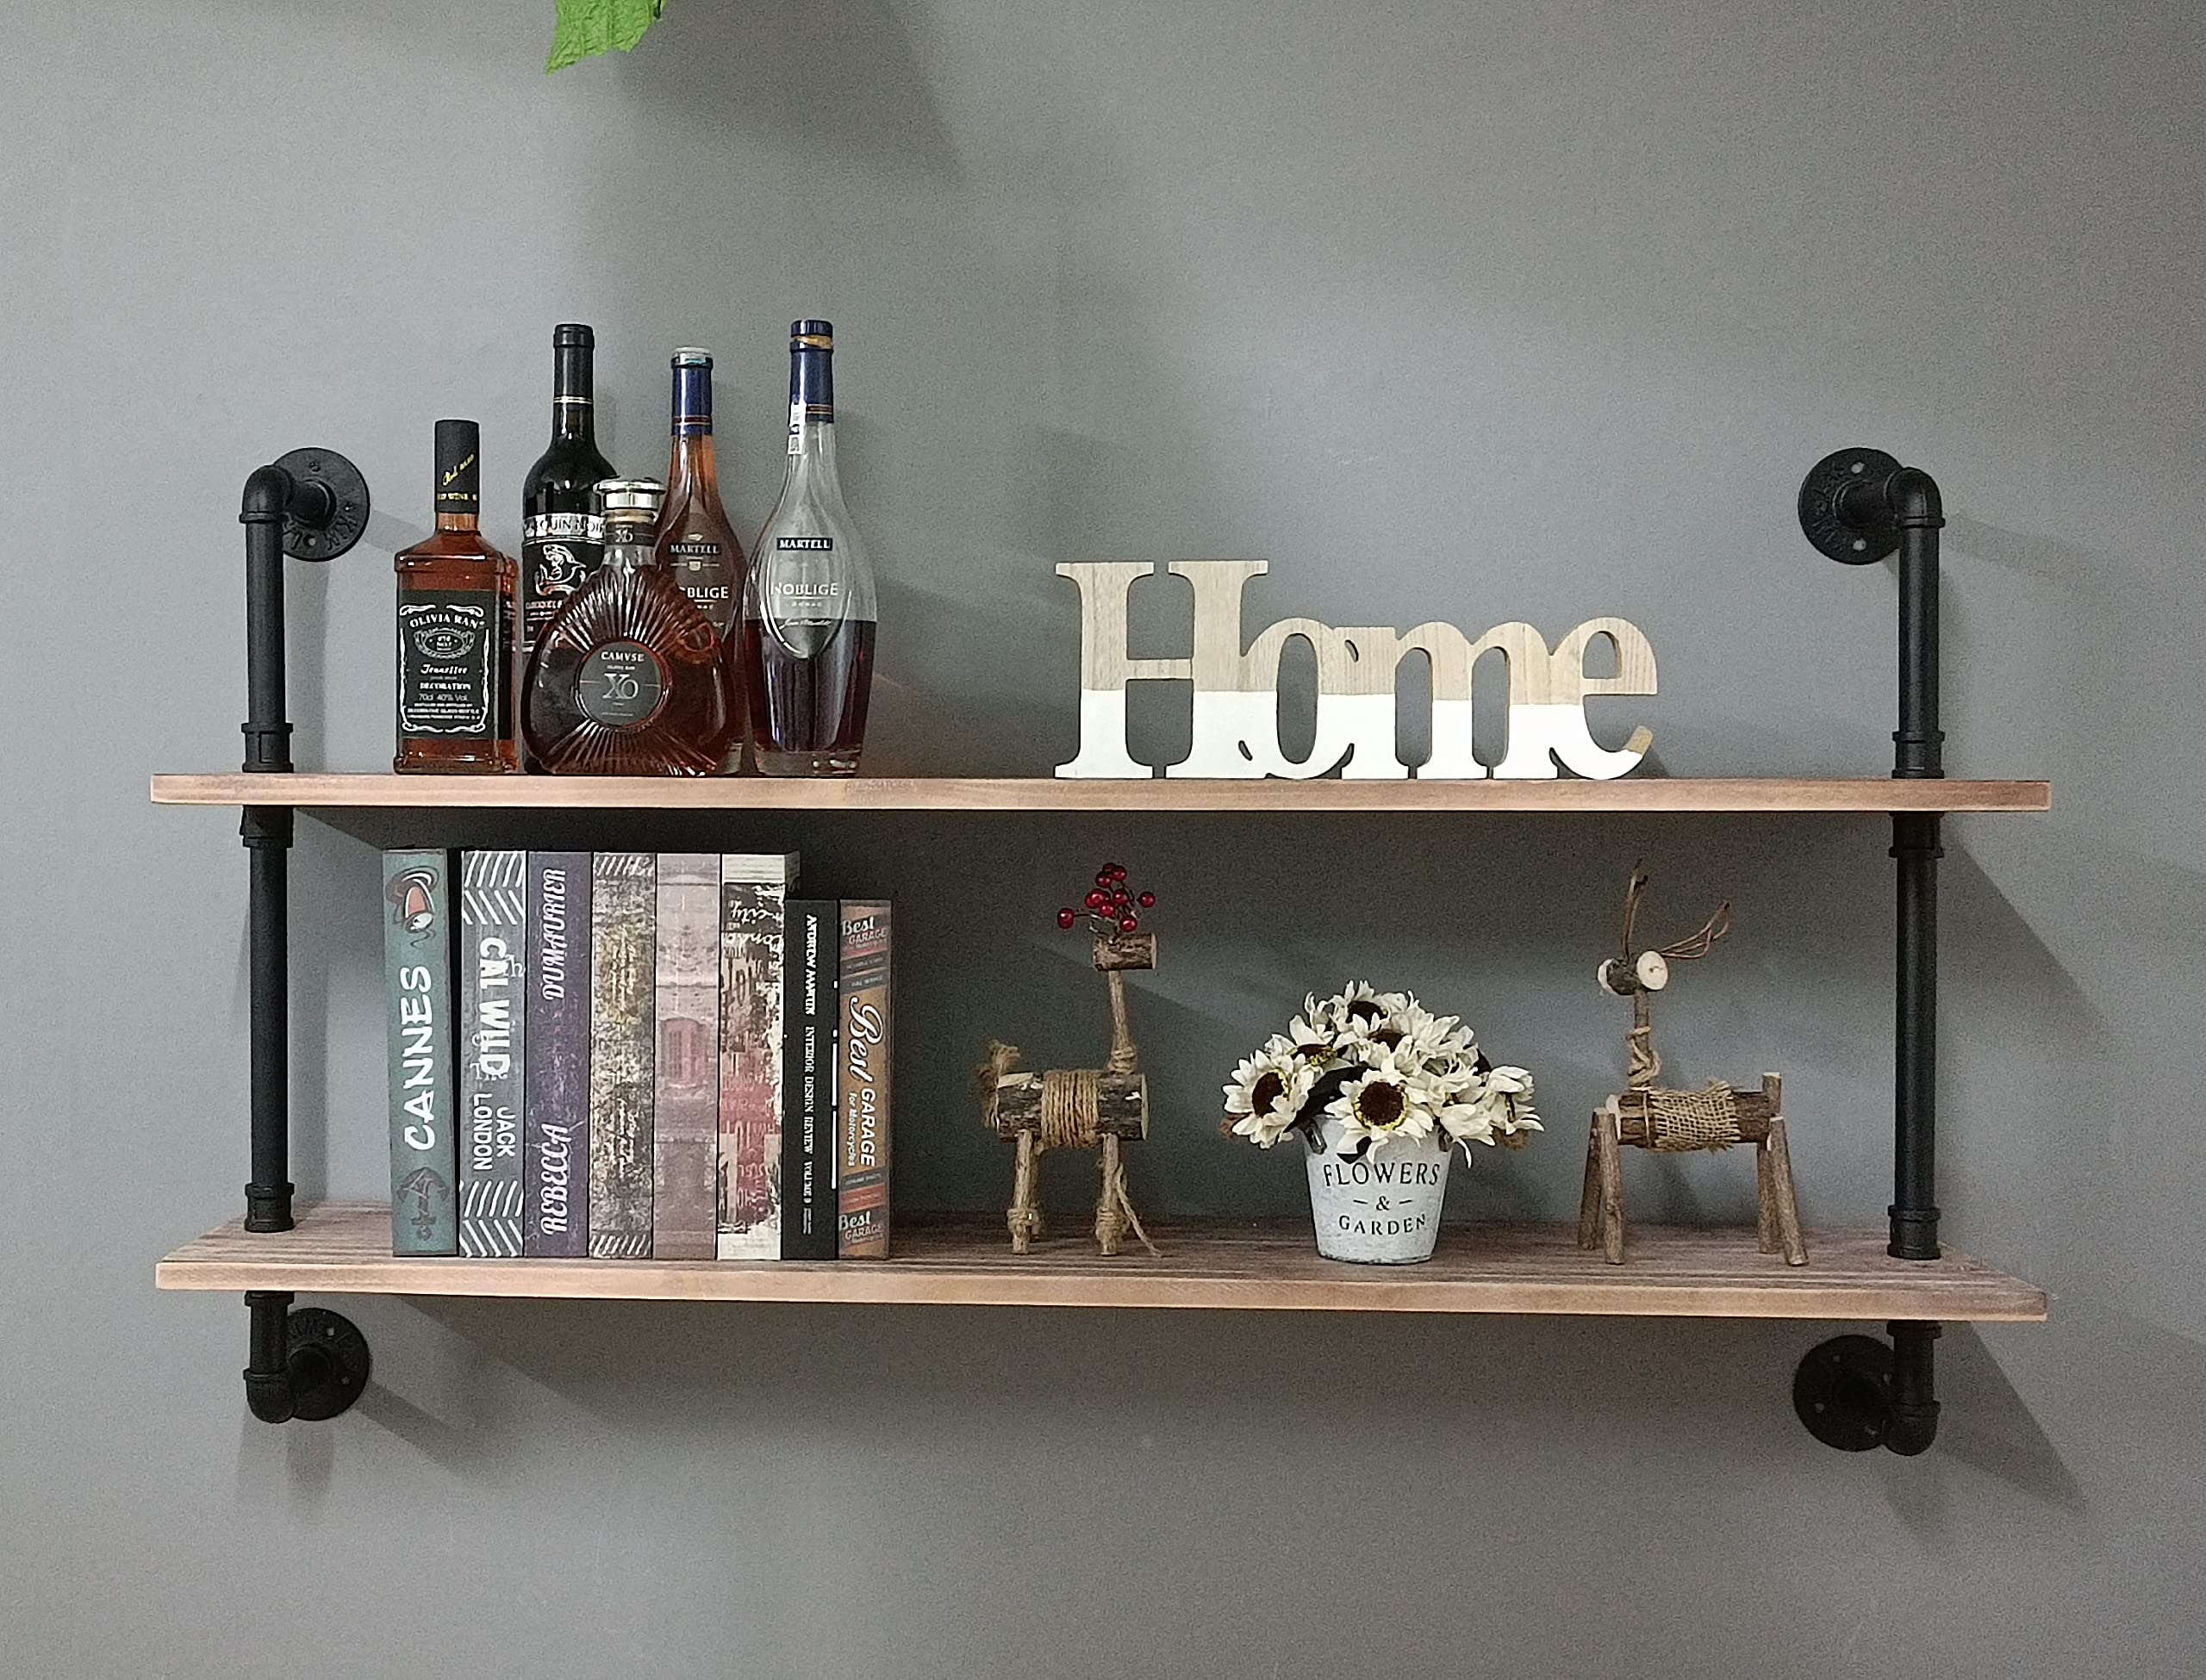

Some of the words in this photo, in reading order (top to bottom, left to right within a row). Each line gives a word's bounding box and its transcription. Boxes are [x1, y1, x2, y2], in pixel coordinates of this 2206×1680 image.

[670, 544, 720, 554] MARTELL
[778, 539, 831, 549] MARTELL
[687, 586, 729, 600] BLIGE
[770, 582, 839, 596] NOBLIGE
[409, 613, 451, 628] OLIVIA
[1055, 560, 1658, 780] Home
[841, 916, 875, 936] Best
[849, 927, 888, 944] GARAGE
[804, 1026, 815, 1073] INTERIOR
[849, 996, 883, 1083] Best
[400, 965, 436, 1151] CANNES
[803, 1076, 814, 1113] DESIGN
[848, 1092, 857, 1107] for
[473, 1092, 493, 1170] LONDON
[496, 1106, 516, 1157] JACK
[803, 1117, 814, 1154] REVIEW
[847, 1108, 857, 1167] Motorcycles
[861, 1088, 876, 1167] GARAGE
[540, 1123, 571, 1235] REBECCA
[1323, 1162, 1441, 1187] FLOWERS
[838, 1210, 871, 1231] Best
[844, 1223, 883, 1241] GARAGE
[1338, 1213, 1426, 1235] GARDEN
